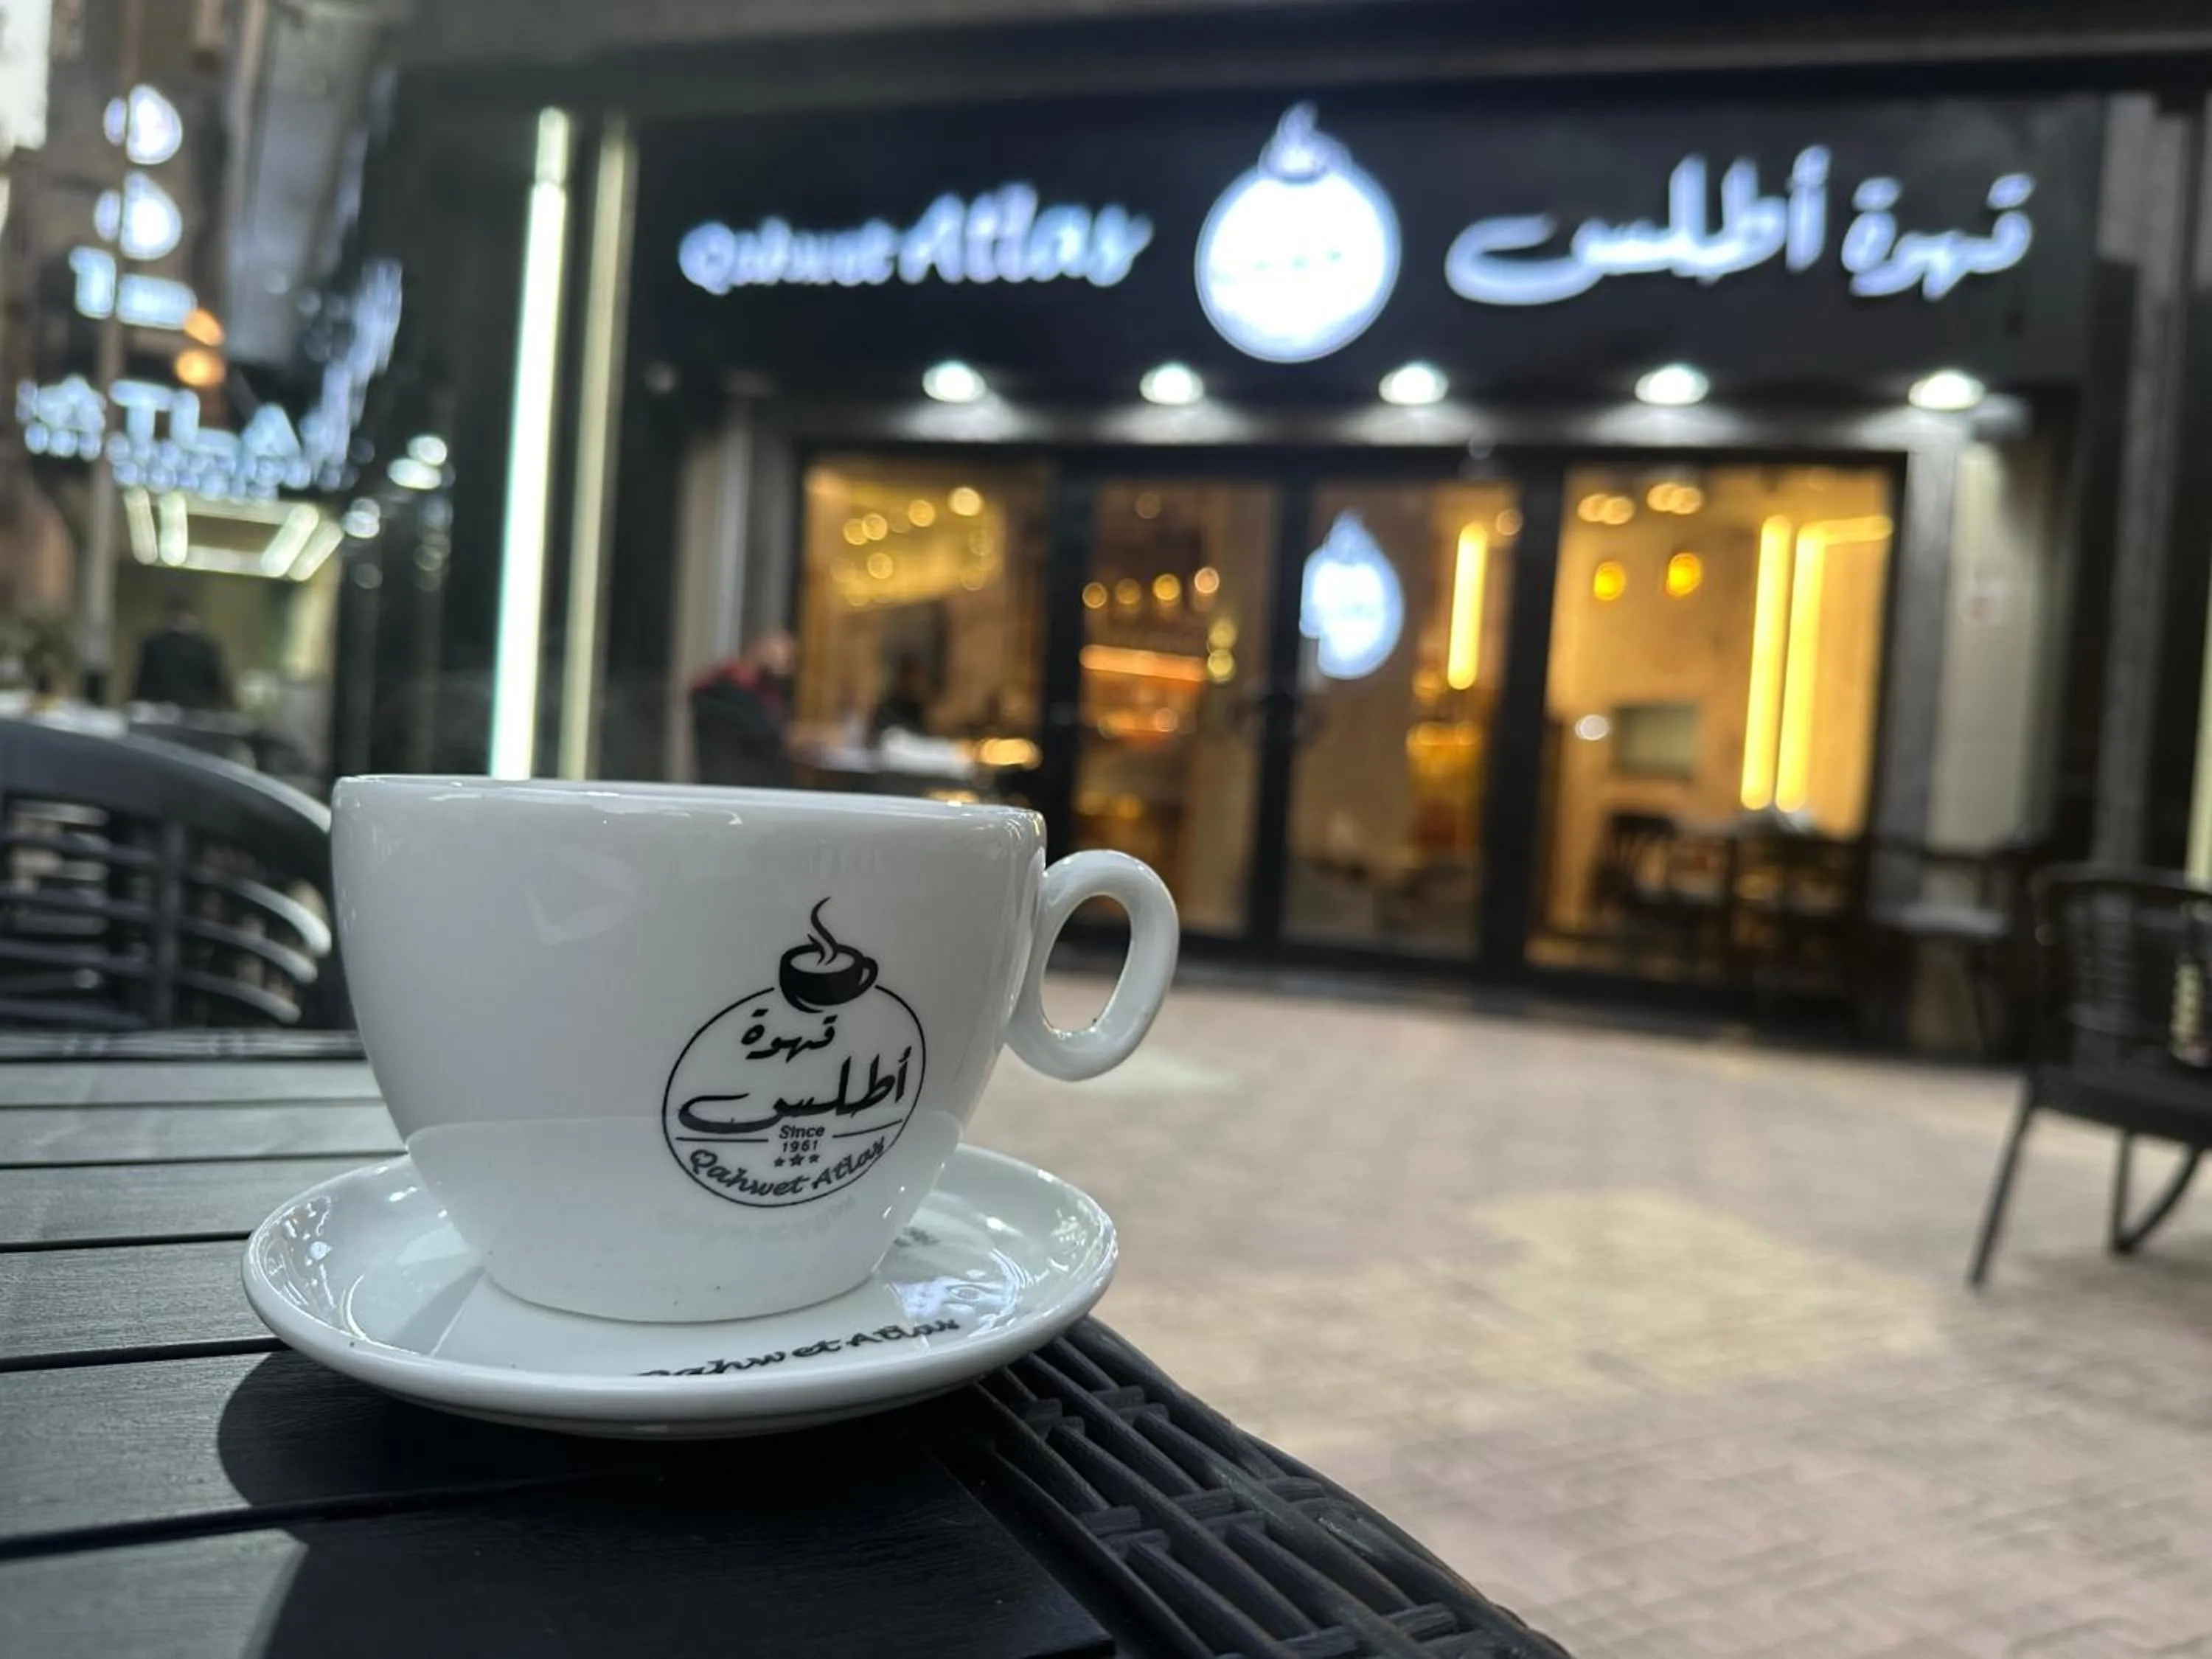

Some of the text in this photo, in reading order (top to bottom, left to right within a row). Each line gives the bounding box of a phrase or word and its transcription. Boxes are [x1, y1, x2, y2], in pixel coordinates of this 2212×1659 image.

[1444, 146, 2035, 305] قهوة أطلس
[740, 1009, 838, 1062] قهوة
[678, 1046, 912, 1134] أطلس
[779, 1124, 825, 1139] Since
[782, 1139, 818, 1153] 1961
[689, 1149, 810, 1197] Qahwet
